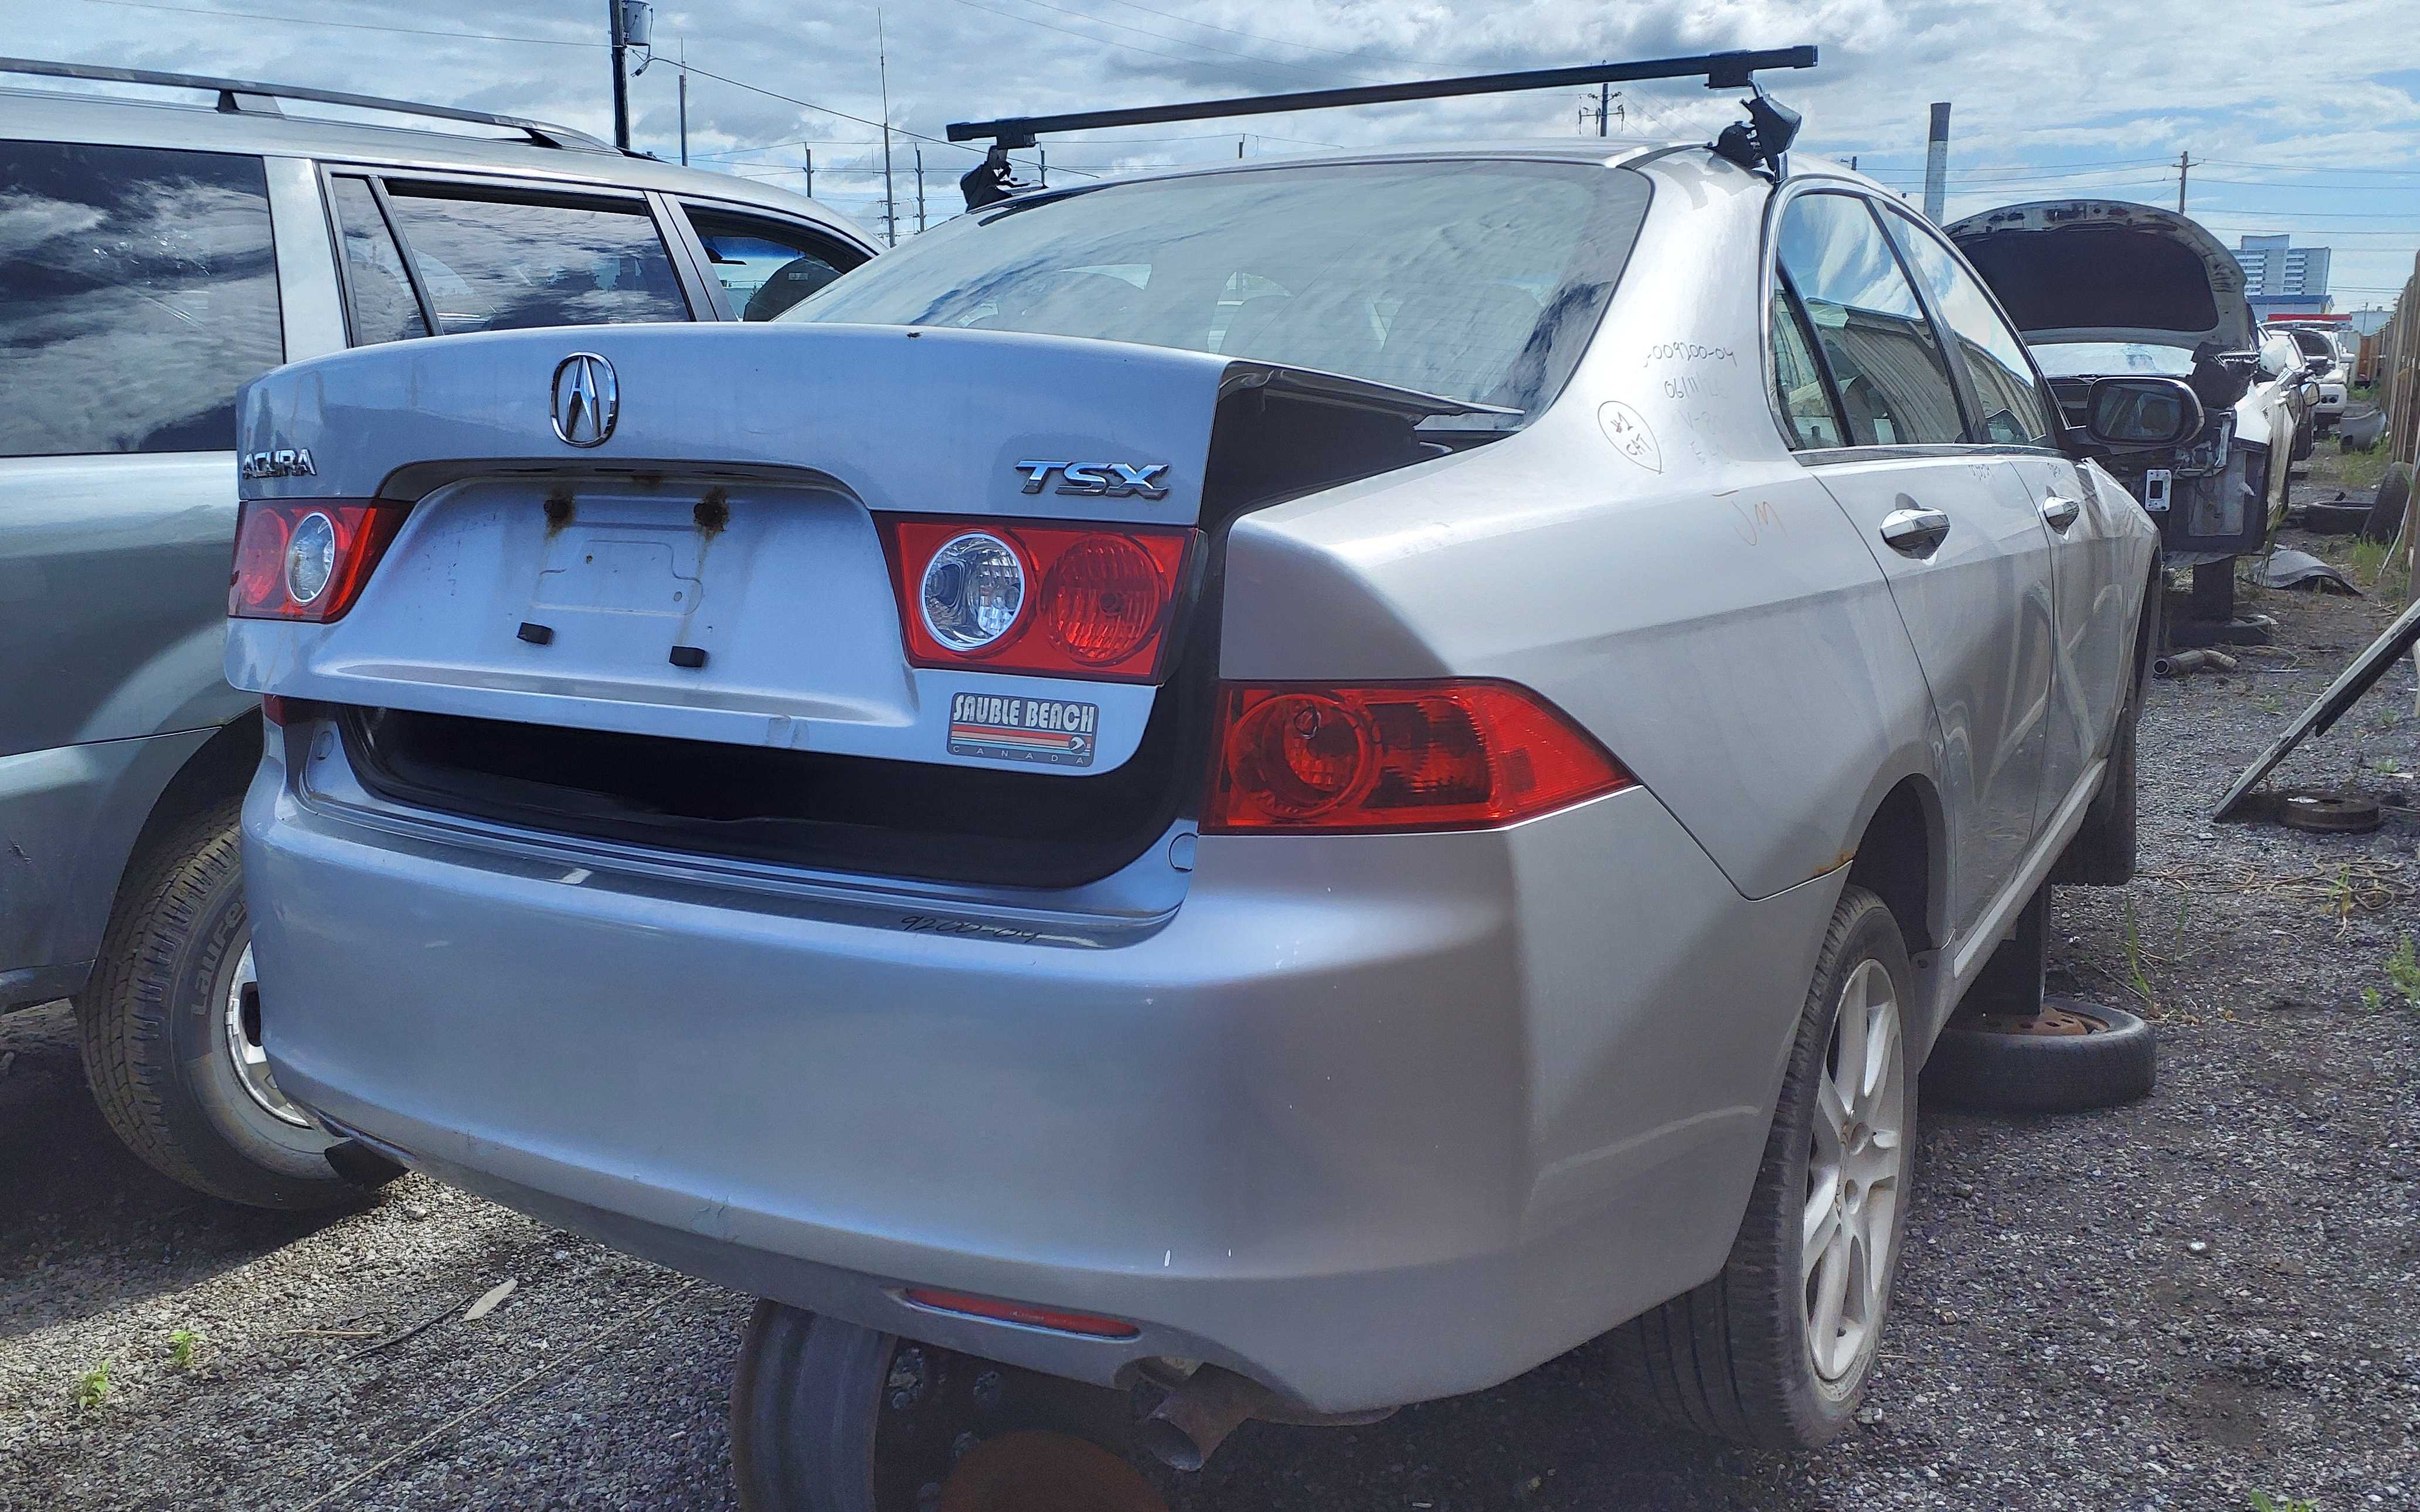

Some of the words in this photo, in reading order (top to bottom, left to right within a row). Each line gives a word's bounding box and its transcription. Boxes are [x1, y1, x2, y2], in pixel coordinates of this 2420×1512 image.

[242, 448, 318, 479] ACURA
[1014, 459, 1169, 500] TSX
[953, 694, 1021, 726] SAUBLE
[1025, 700, 1095, 733] BEACH
[952, 745, 1084, 765] CANADA
